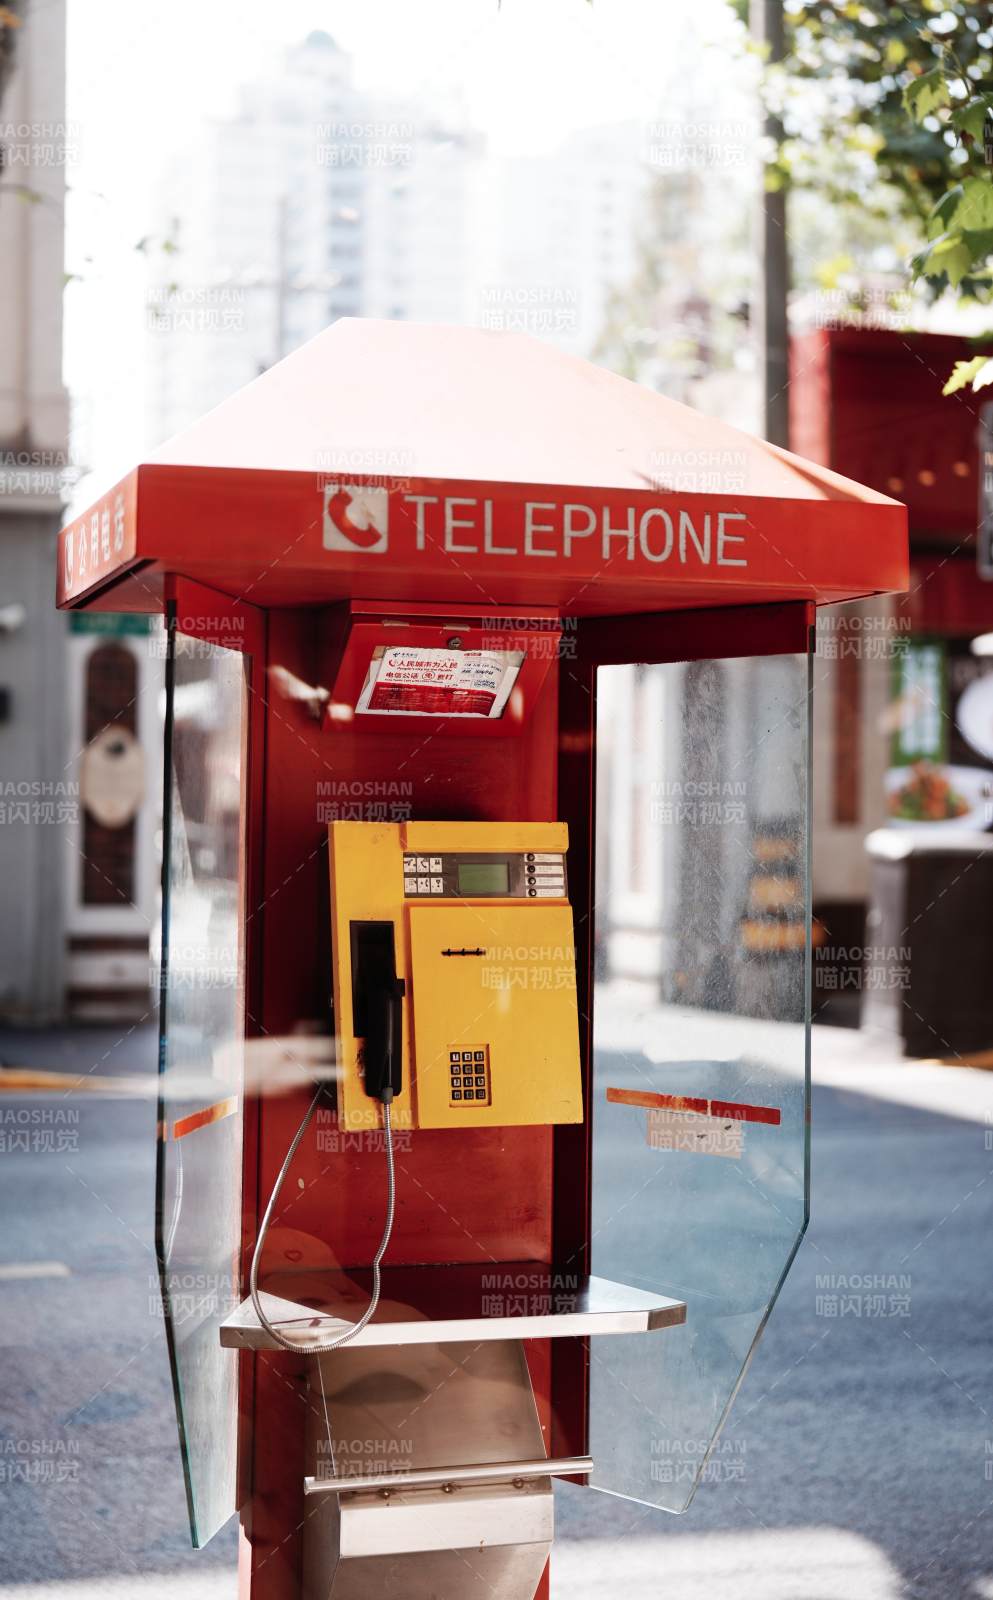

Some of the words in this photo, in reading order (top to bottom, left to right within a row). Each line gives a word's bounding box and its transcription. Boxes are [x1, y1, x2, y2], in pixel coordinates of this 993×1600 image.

[78, 492, 125, 577] 公用电话
[404, 495, 748, 566] TELEPHONE
